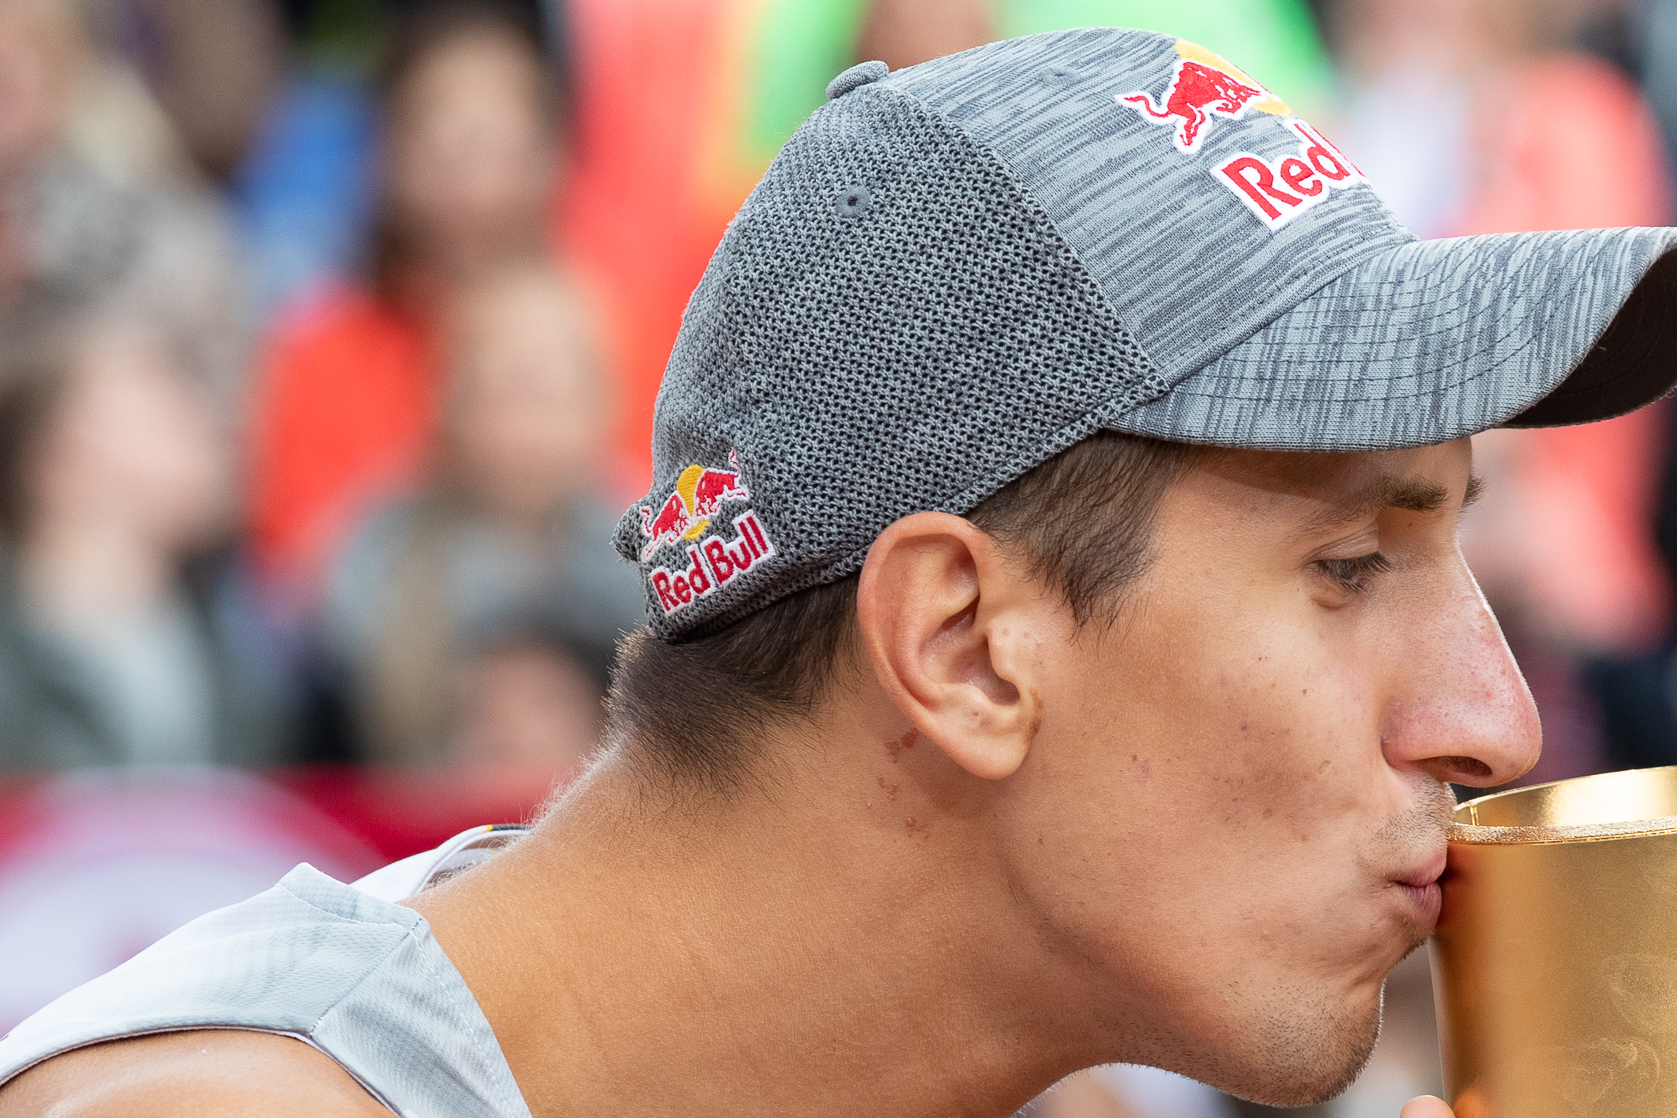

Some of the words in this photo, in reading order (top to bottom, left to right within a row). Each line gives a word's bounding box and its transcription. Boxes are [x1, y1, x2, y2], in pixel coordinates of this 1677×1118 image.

[1222, 122, 1351, 221] Red
[652, 550, 712, 611] Red
[703, 515, 769, 586] Bull
